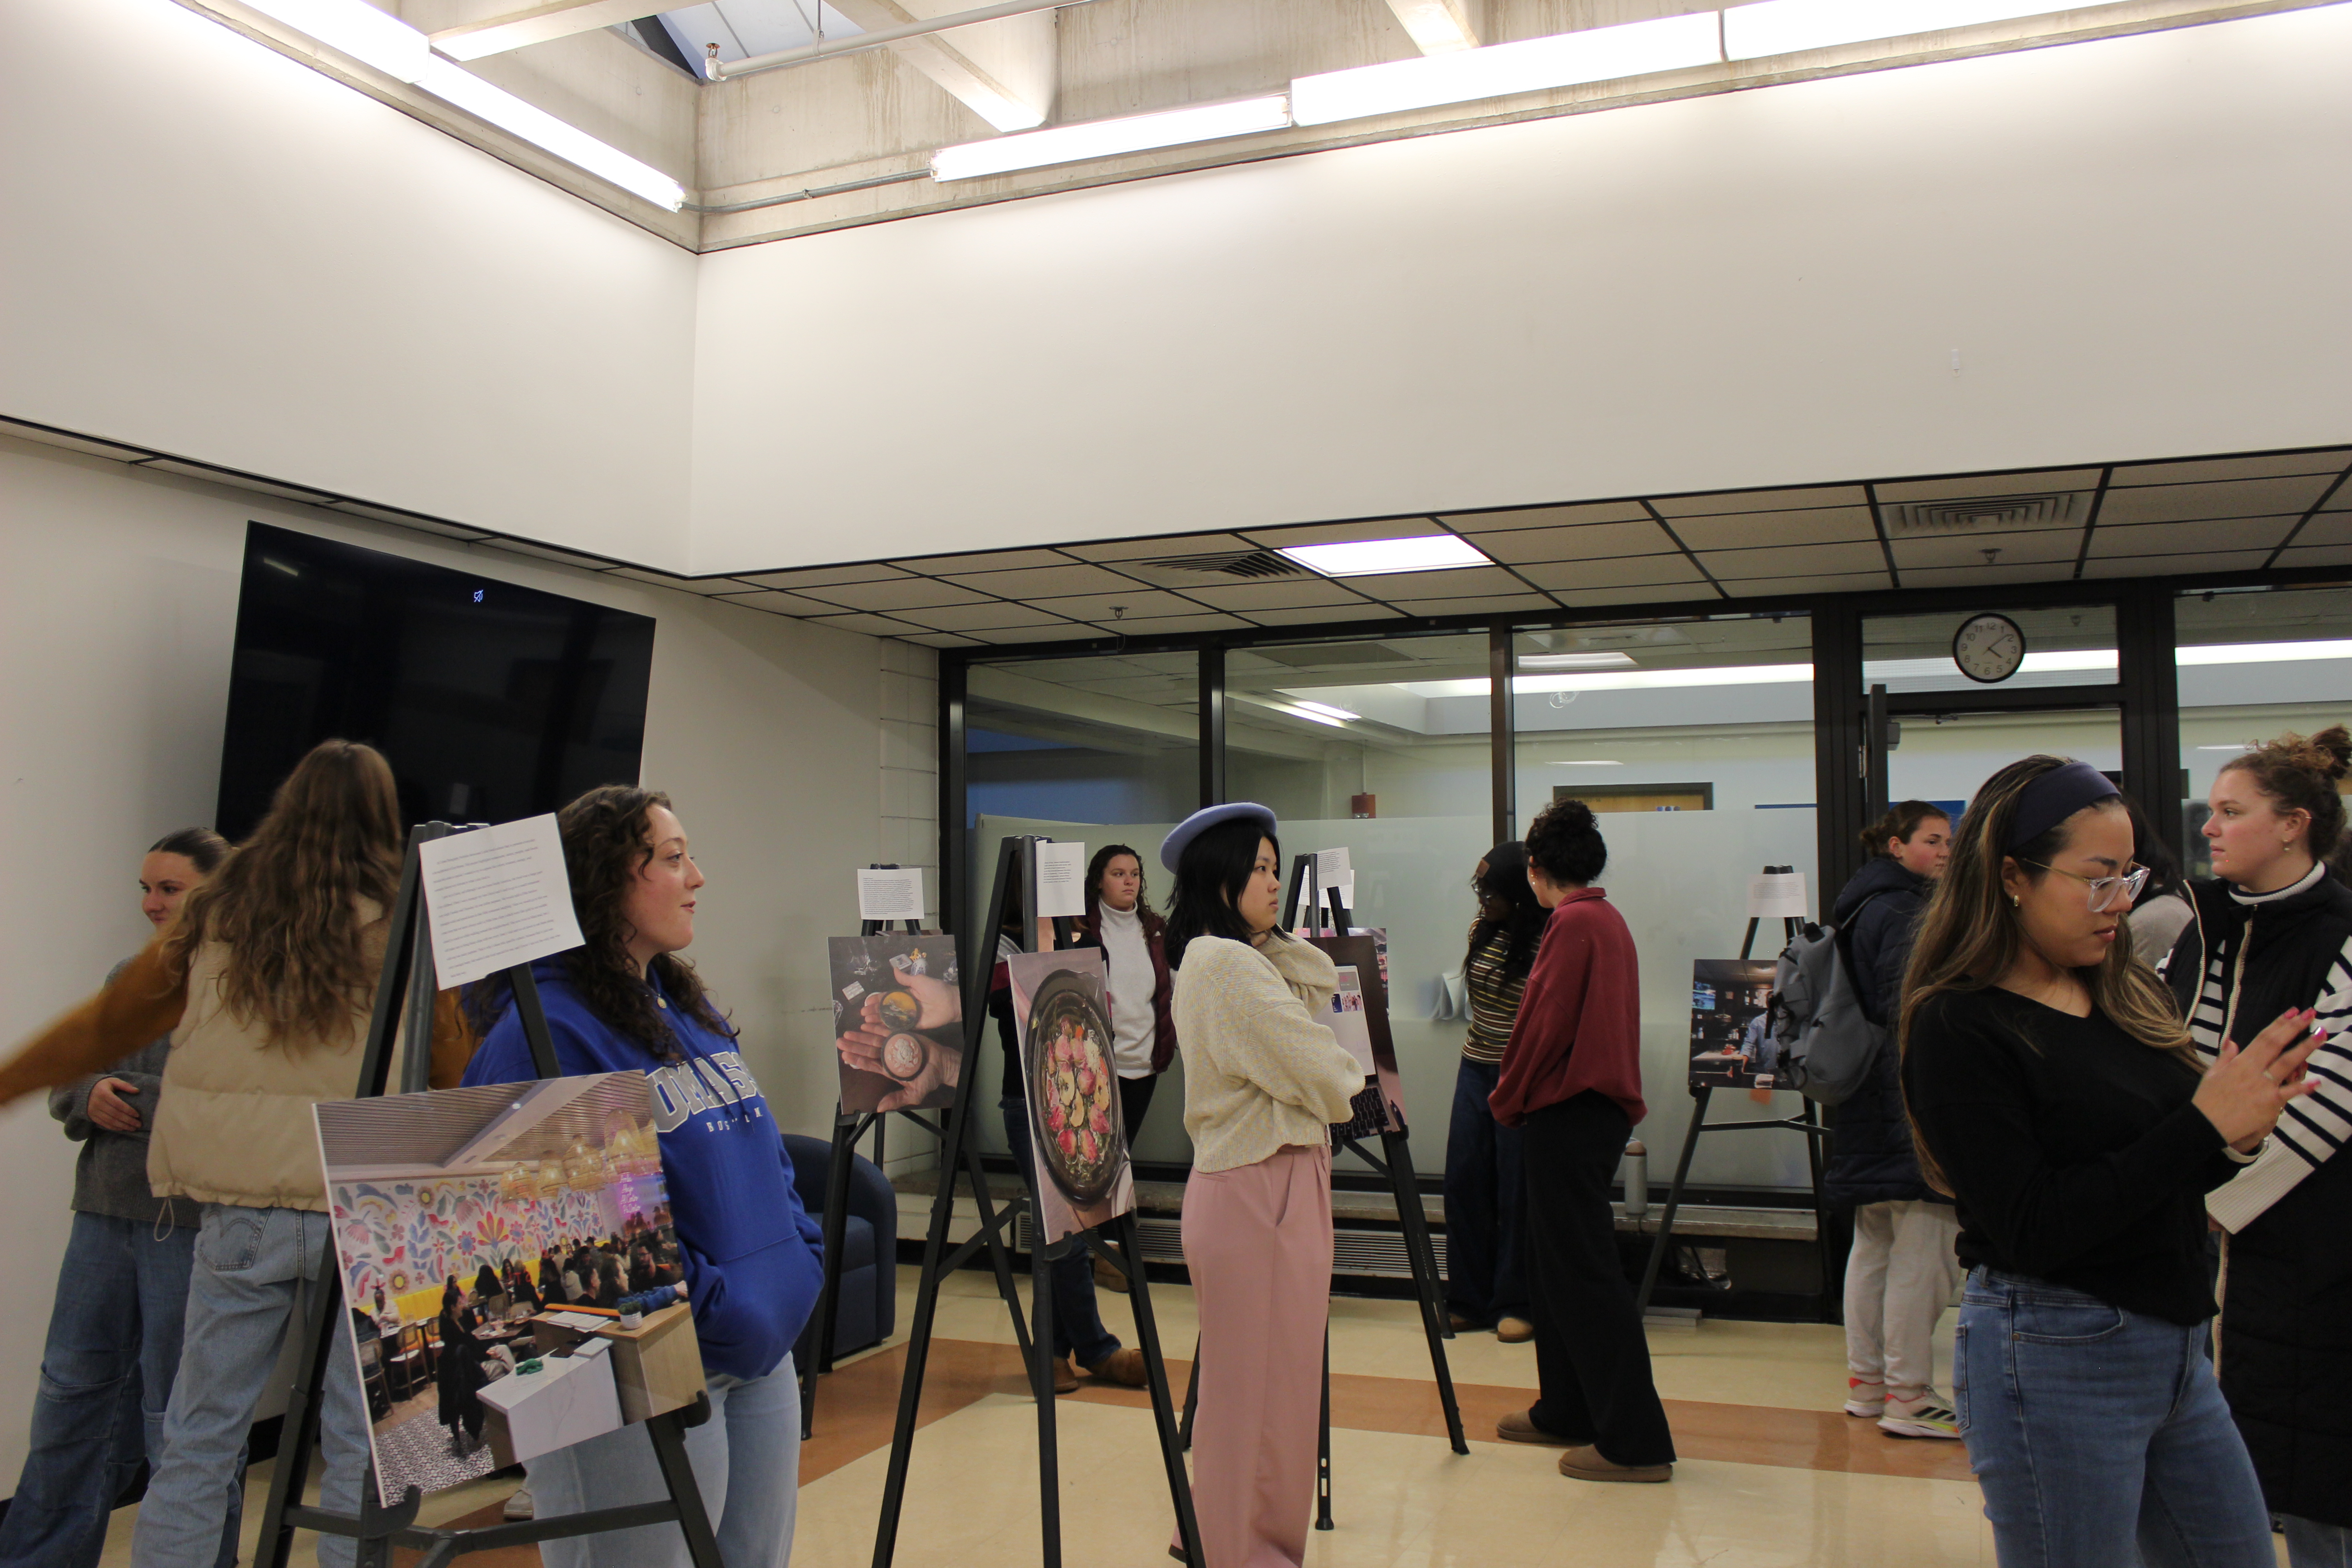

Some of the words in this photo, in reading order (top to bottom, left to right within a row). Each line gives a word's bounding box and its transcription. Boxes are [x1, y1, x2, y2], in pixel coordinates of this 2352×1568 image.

[1966, 633, 1975, 641] 10
[2007, 634, 2014, 642] 2
[1965, 655, 1970, 663] 8
[1984, 667, 1991, 675] 6
[1996, 665, 2003, 673] 5
